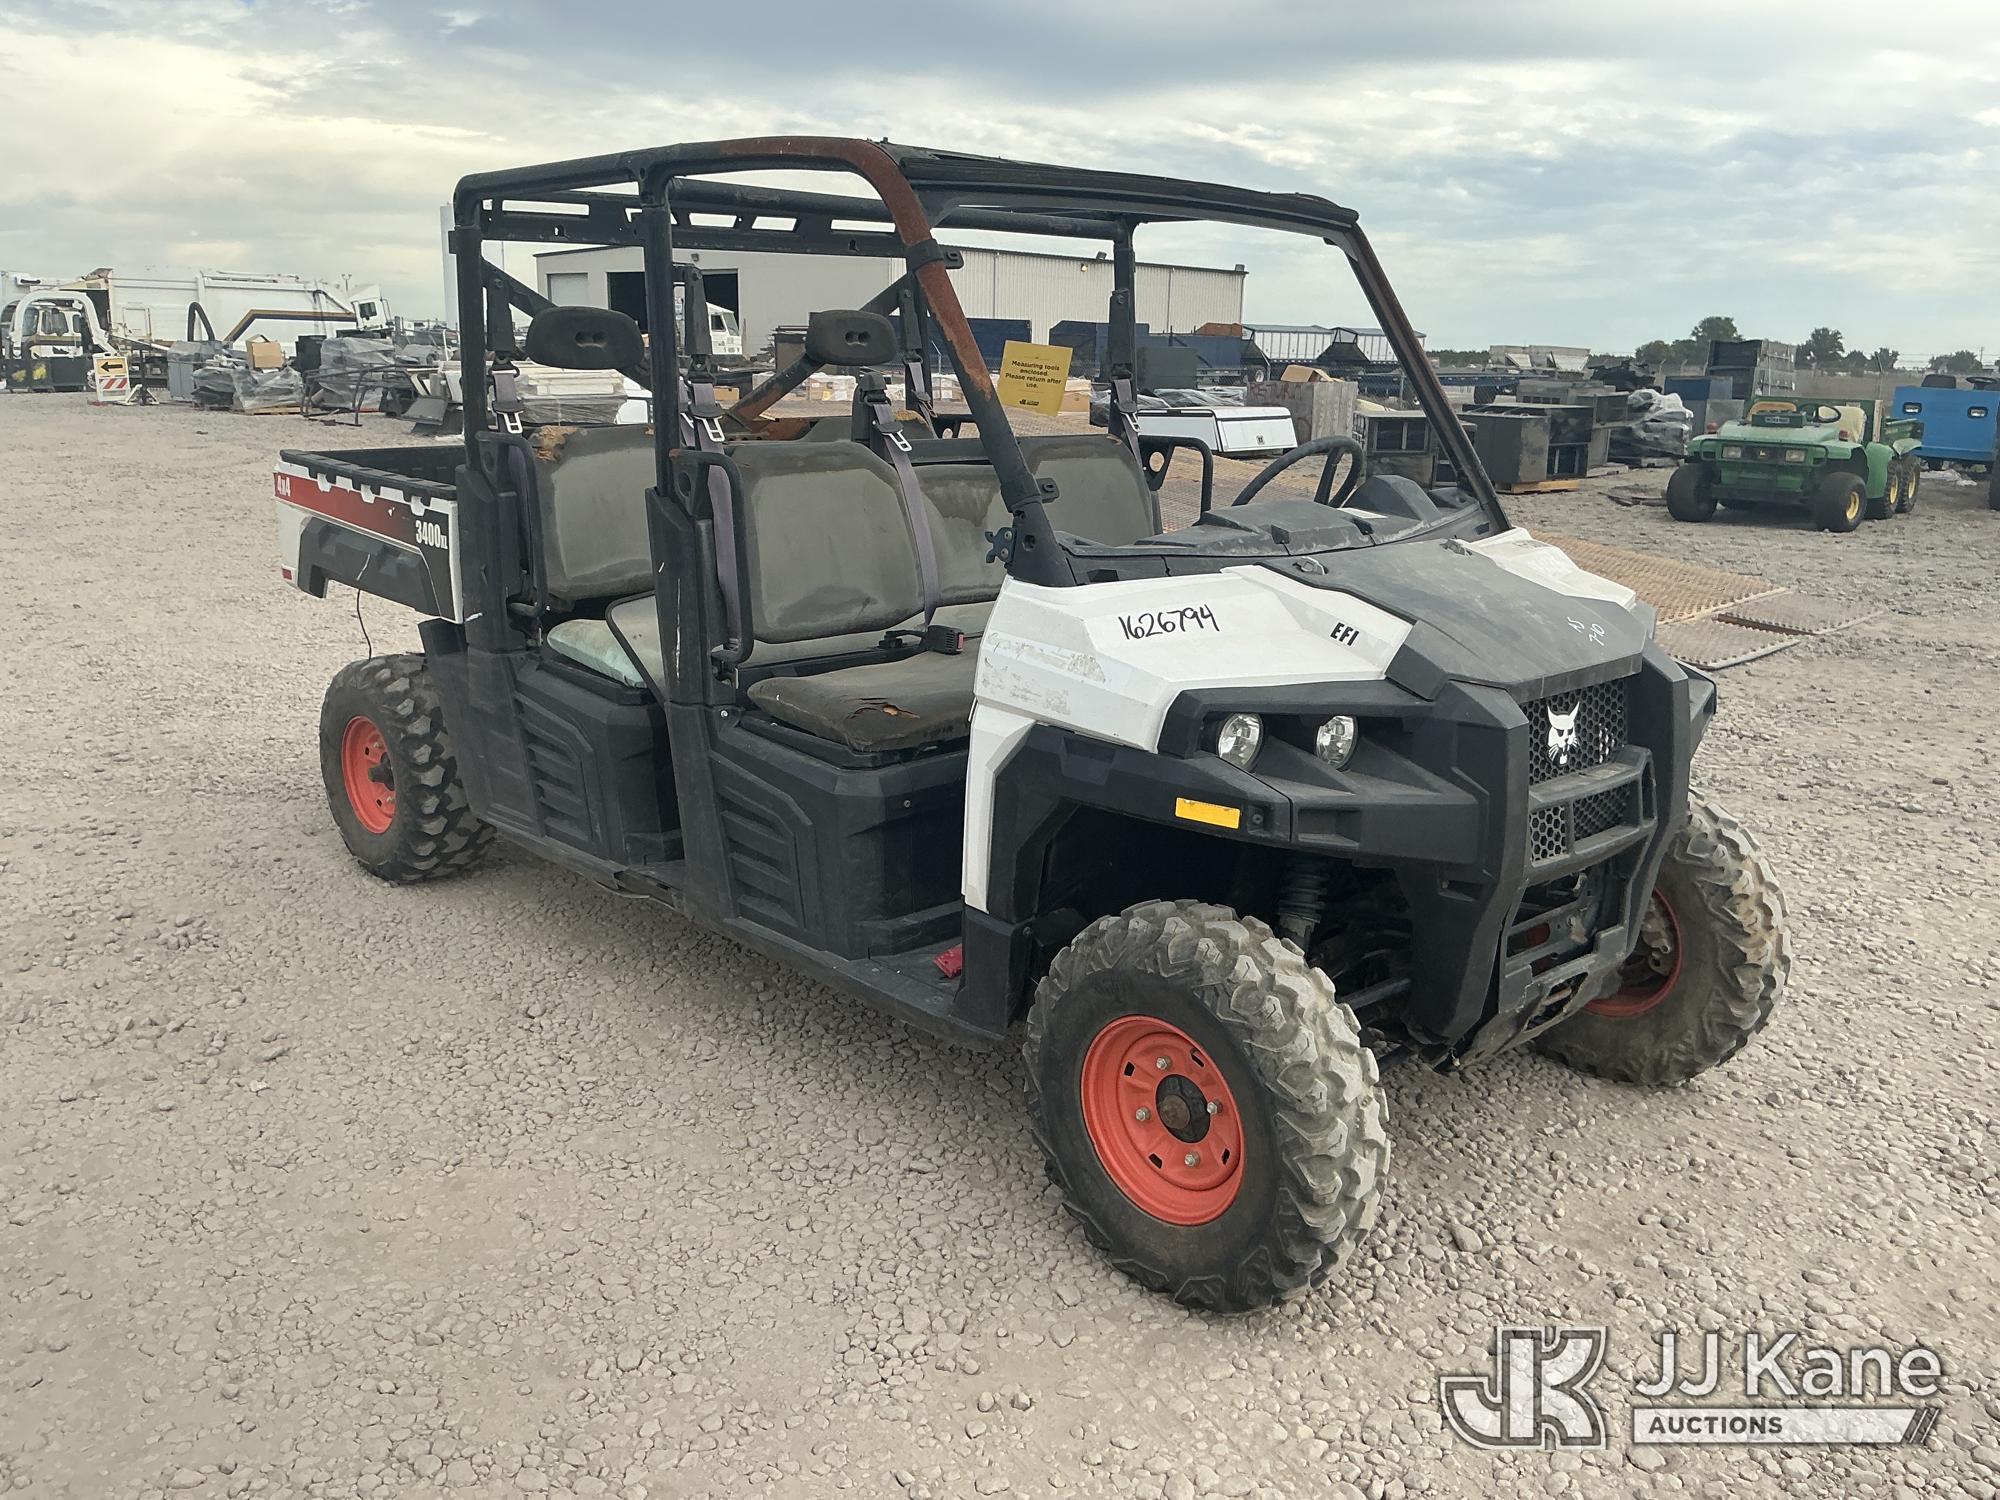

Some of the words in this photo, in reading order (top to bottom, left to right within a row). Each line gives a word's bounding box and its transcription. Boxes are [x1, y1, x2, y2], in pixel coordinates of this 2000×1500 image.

[1011, 360, 1043, 370] Measuring
[1005, 372, 1026, 381] Please
[1026, 375, 1046, 383] return
[1118, 603, 1220, 640] 1626794
[1329, 621, 1360, 647] EFI
